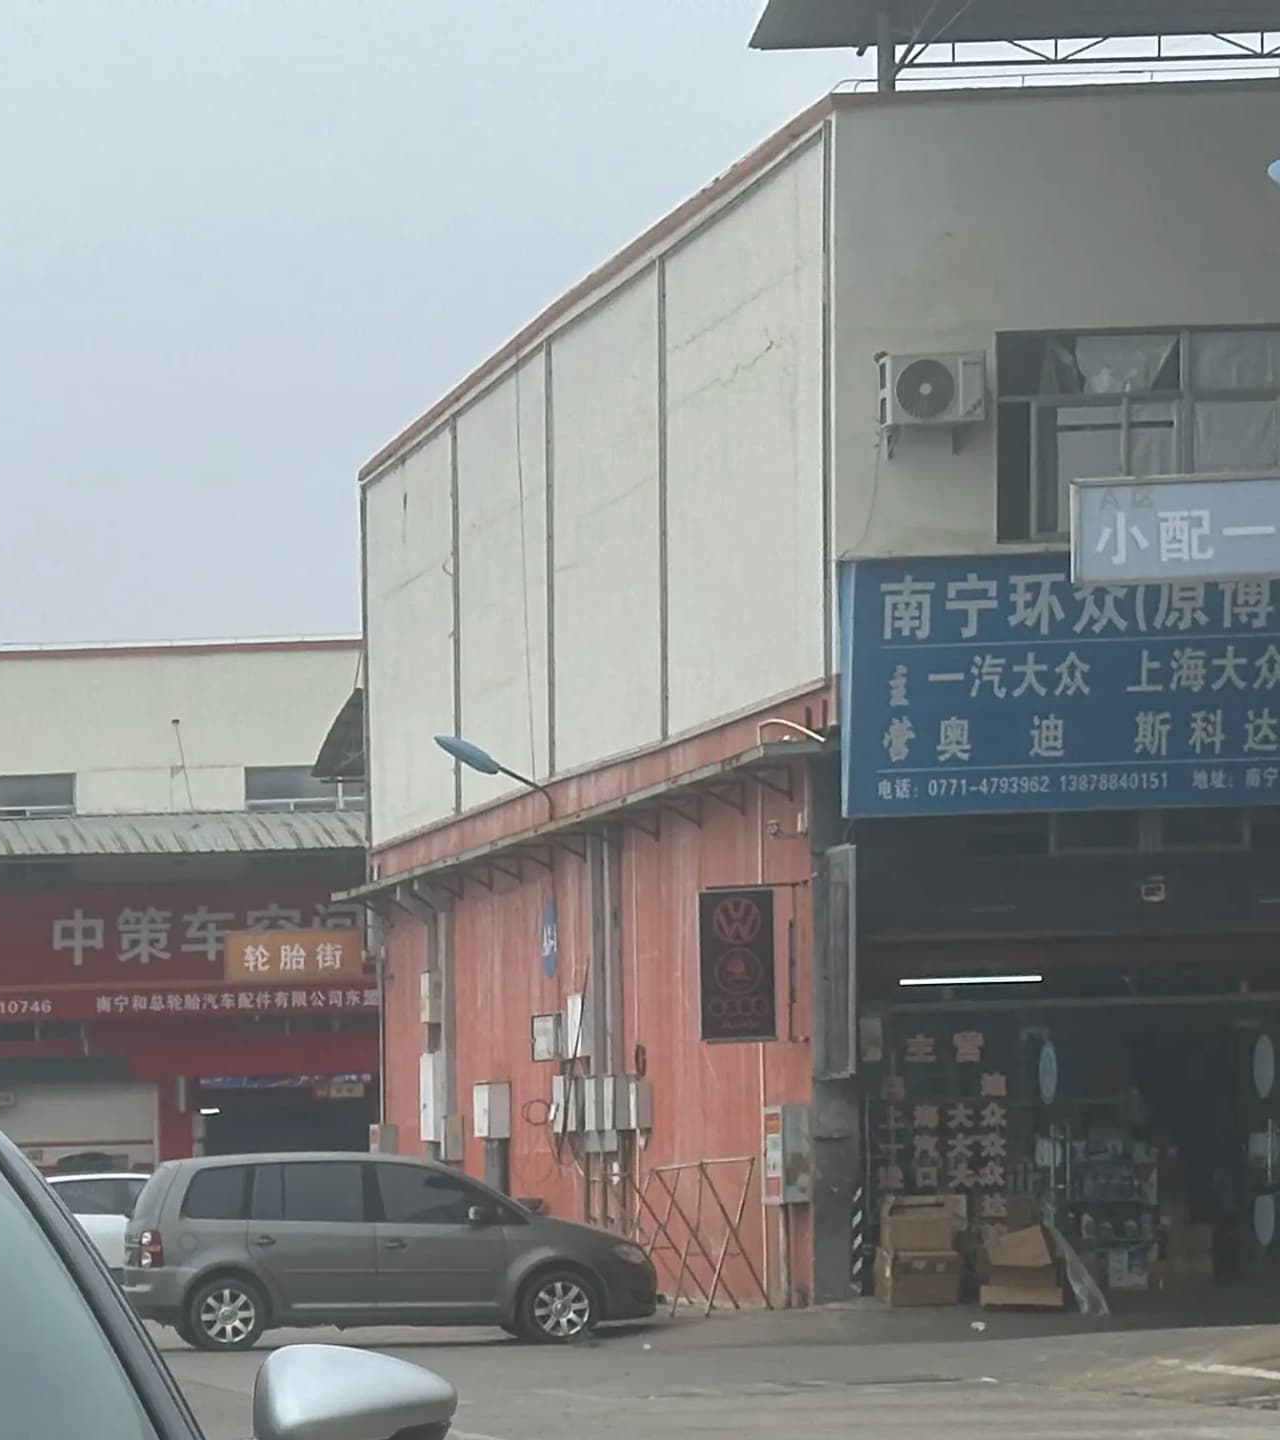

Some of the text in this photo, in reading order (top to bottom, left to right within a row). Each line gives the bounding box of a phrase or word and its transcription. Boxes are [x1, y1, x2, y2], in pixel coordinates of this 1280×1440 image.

[1095, 509, 1276, 565] 小配一
[928, 645, 1280, 699] 一汽大众 上海大众
[936, 714, 1065, 762] 奥迪
[243, 943, 343, 972] 轮胎街
